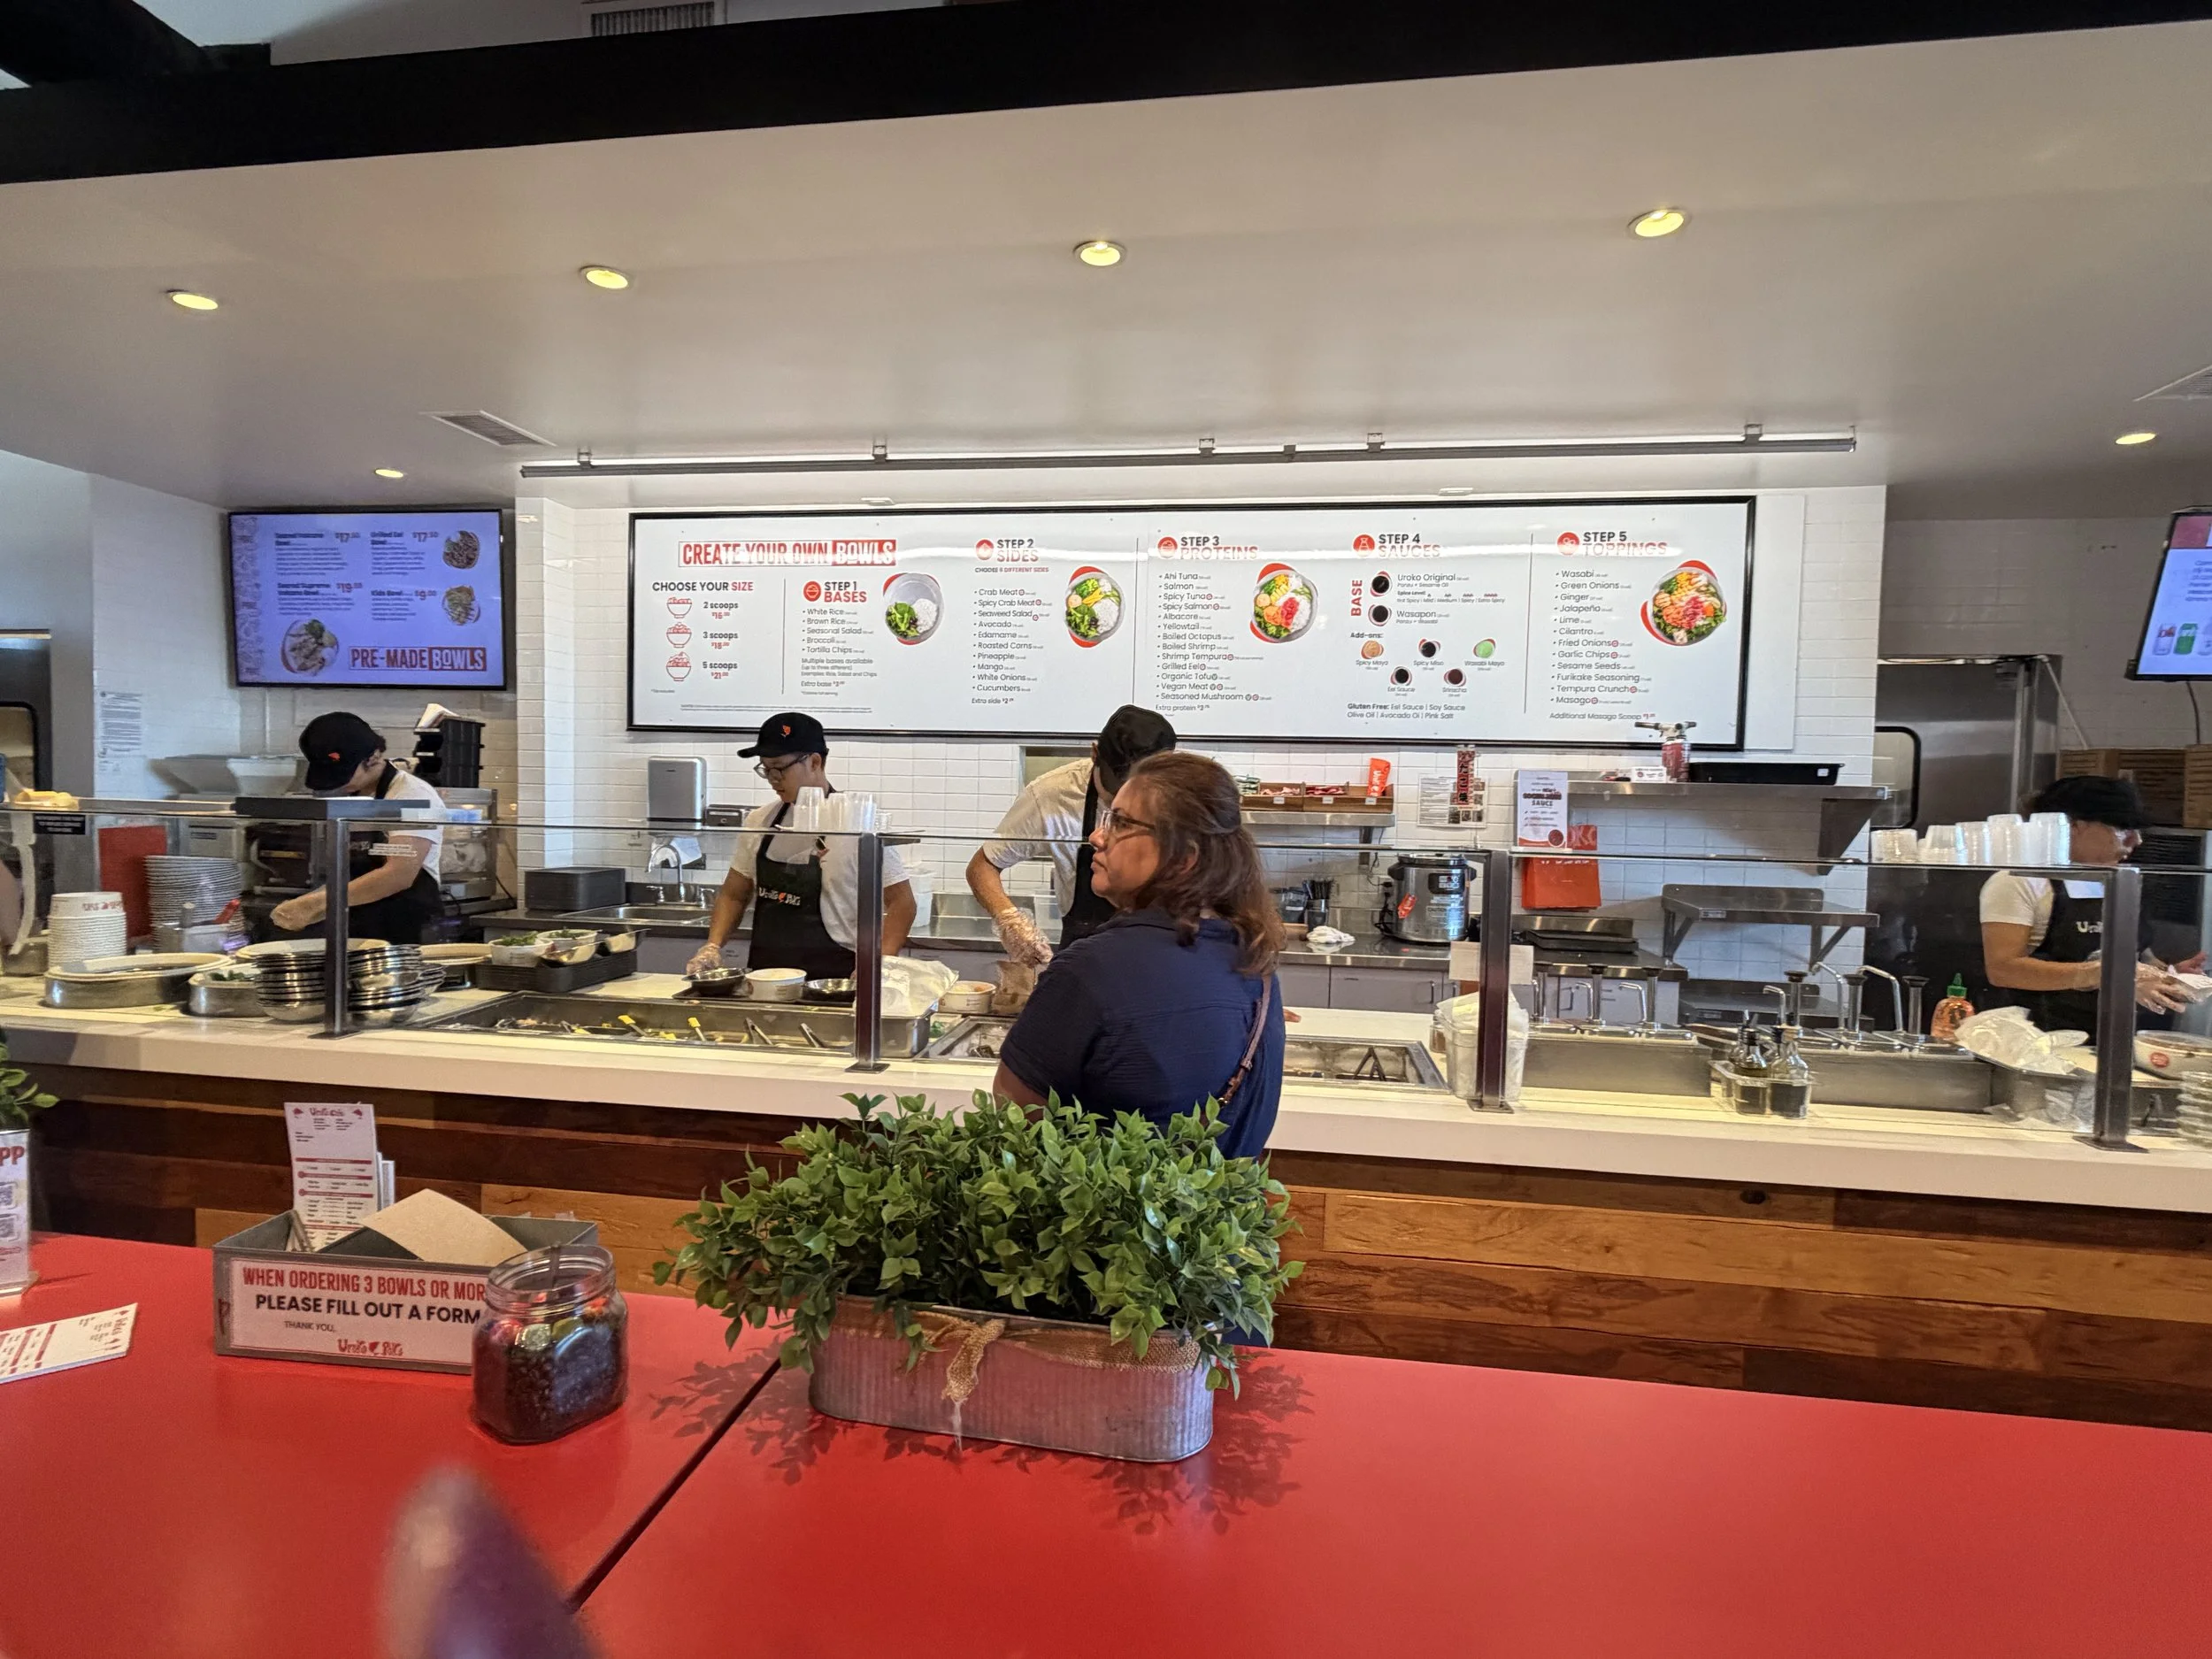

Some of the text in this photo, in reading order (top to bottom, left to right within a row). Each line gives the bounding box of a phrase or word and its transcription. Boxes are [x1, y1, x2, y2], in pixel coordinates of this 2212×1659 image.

[1180, 535, 1220, 546] STEP 3
[1379, 533, 1421, 544] STEP 4
[1583, 531, 1627, 542] STEP 5
[996, 538, 1034, 549] STEP 2
[683, 541, 894, 565] CREATE YOUR OWN BOWLS
[1180, 546, 1258, 560] PROTEINS
[1378, 544, 1440, 558] SAUCES
[1582, 541, 1667, 557] TOPPINGS
[996, 549, 1039, 562] SIDES
[1423, 573, 1456, 583] Original
[1561, 569, 1594, 578] Wasabi
[652, 581, 754, 592] CHOOSE YOUR SIZE
[824, 581, 850, 591] STEP
[824, 591, 867, 603] BASES
[1163, 593, 1185, 602] Spicy
[1350, 580, 1363, 617] BASE
[1560, 593, 1589, 603] Ginger
[710, 603, 739, 611] scoops
[1163, 603, 1183, 611] Spicy
[1396, 611, 1437, 620] Wasapon
[710, 632, 739, 641] scoops
[1188, 633, 1221, 641] Octopus
[832, 646, 852, 655] Chips
[1585, 650, 1610, 659] Chips
[350, 648, 483, 669] PRE-MADE BOWLS
[709, 662, 738, 671] scoops
[1161, 672, 1193, 681] Organic
[1594, 673, 1640, 683] Seasoning
[1161, 682, 1187, 691] Vegan
[1556, 685, 1595, 694] Tempura
[1555, 695, 1592, 706] Masago
[1587, 712, 1617, 721] Masago
[242, 1266, 487, 1302] WHEN ORDERING 3 BOWLS OR MOR
[256, 1294, 481, 1325] PLEASE FILL OUT A FORM
[284, 1320, 314, 1331] THANK
